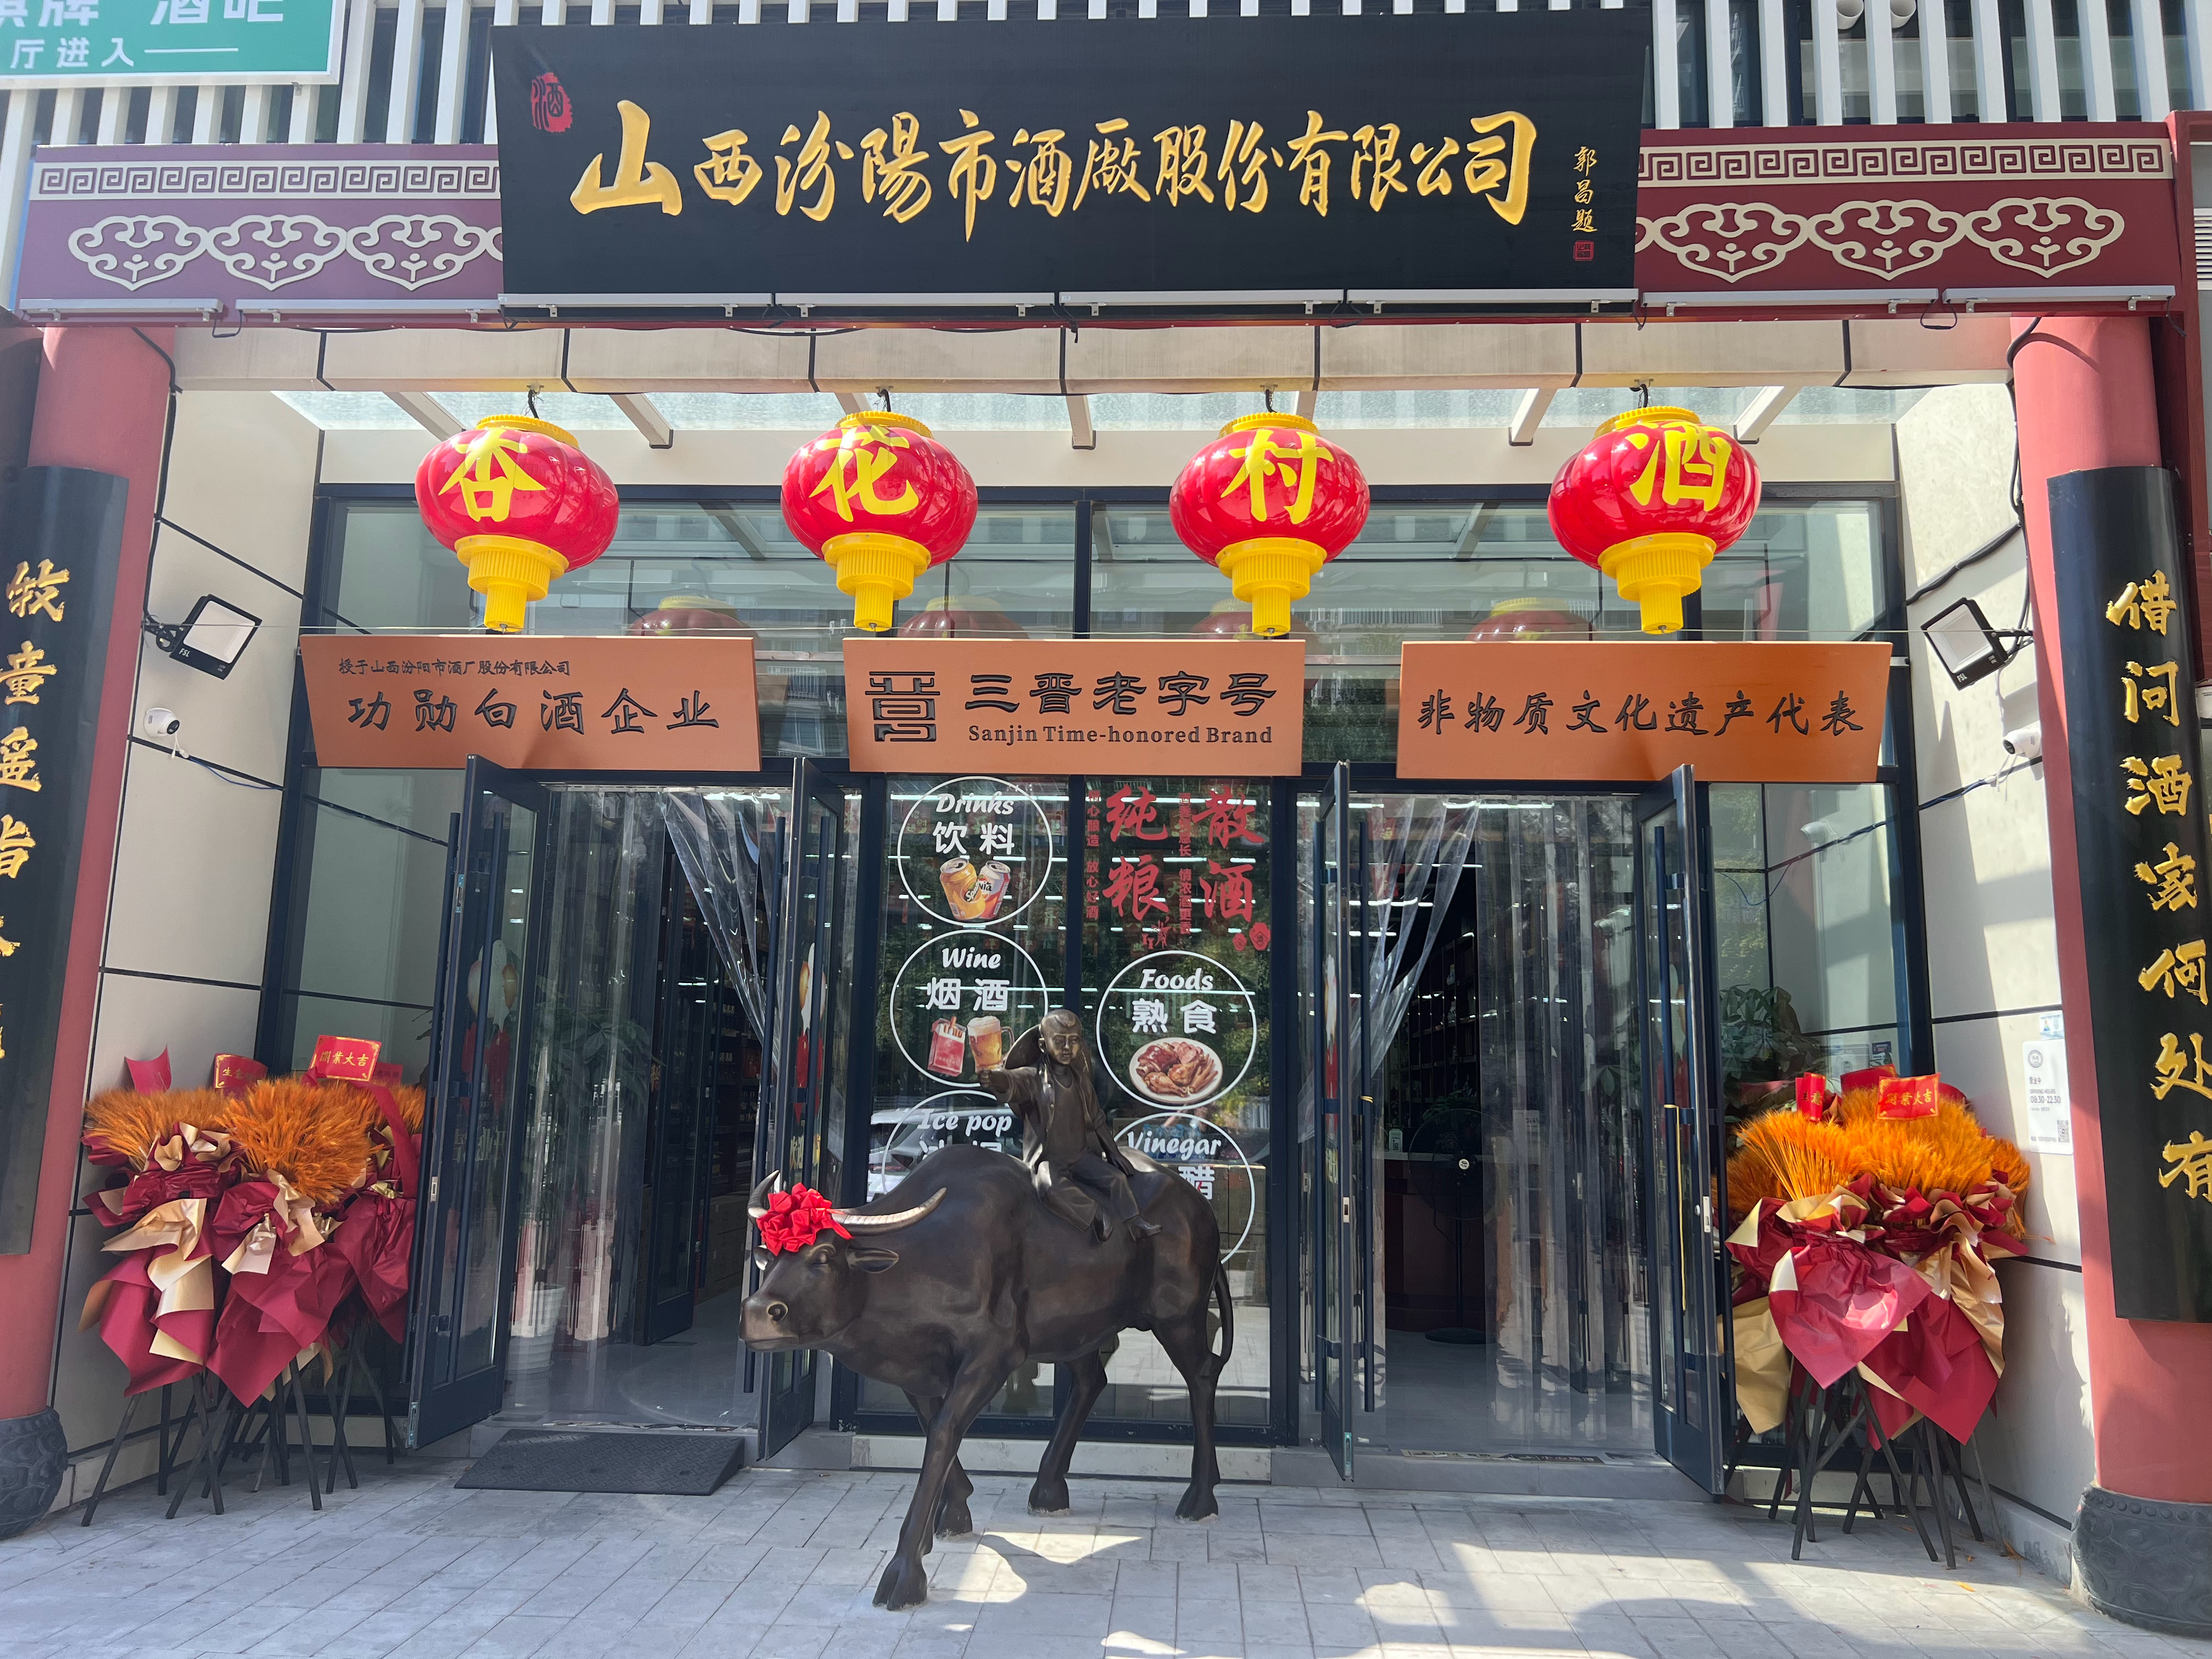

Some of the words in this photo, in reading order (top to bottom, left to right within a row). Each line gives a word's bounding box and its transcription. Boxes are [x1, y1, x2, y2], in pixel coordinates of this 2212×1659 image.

[10, 37, 134, 69] 厅进入
[438, 427, 547, 522] 杏
[1221, 428, 1335, 524] 村
[1627, 421, 1733, 512] 酒
[178, 648, 190, 658] FSL
[964, 670, 1277, 716] 三晋老字号
[347, 687, 720, 736] 功勋白酒企业
[1419, 689, 1865, 736] 非物质文化遗产代表
[968, 725, 1038, 746] Sanjin
[1043, 725, 1200, 743] Time-honored
[1205, 726, 1273, 743] Brand
[935, 791, 1014, 815] Drinks
[932, 821, 1015, 855] 饮料
[941, 946, 1001, 969] Wine
[926, 977, 1010, 1011] 烟酒
[1140, 968, 1214, 991] Foods
[1131, 998, 1217, 1035] 熟食
[917, 1108, 959, 1131] Ice
[965, 1115, 1012, 1138] pop
[1127, 1130, 1222, 1161] Vinegar
